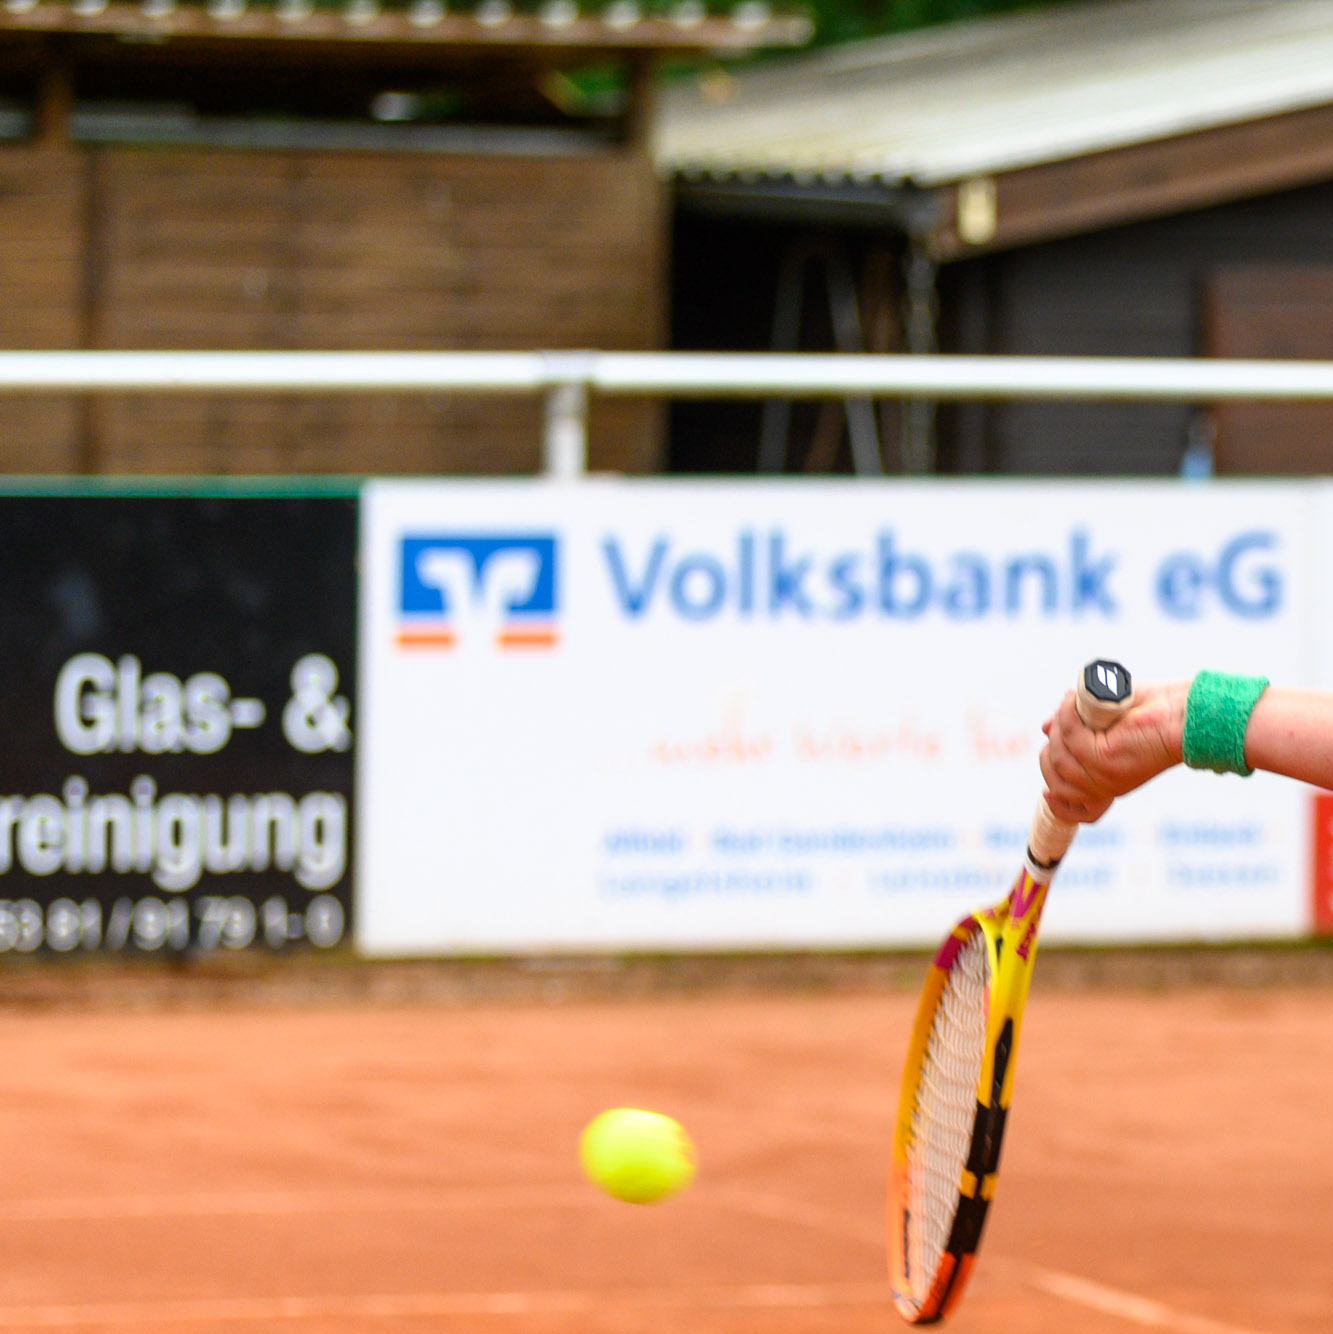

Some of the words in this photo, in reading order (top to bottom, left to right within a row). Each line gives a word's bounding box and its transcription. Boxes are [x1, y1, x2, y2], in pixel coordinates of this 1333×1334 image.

[599, 523, 1118, 625] Volksbank
[1154, 526, 1286, 624] eG
[54, 652, 266, 754] Glas-
[282, 652, 350, 752] &
[0, 774, 347, 892] reinigung
[46, 898, 103, 951] 81
[132, 896, 189, 950] 91
[194, 896, 257, 950] 79
